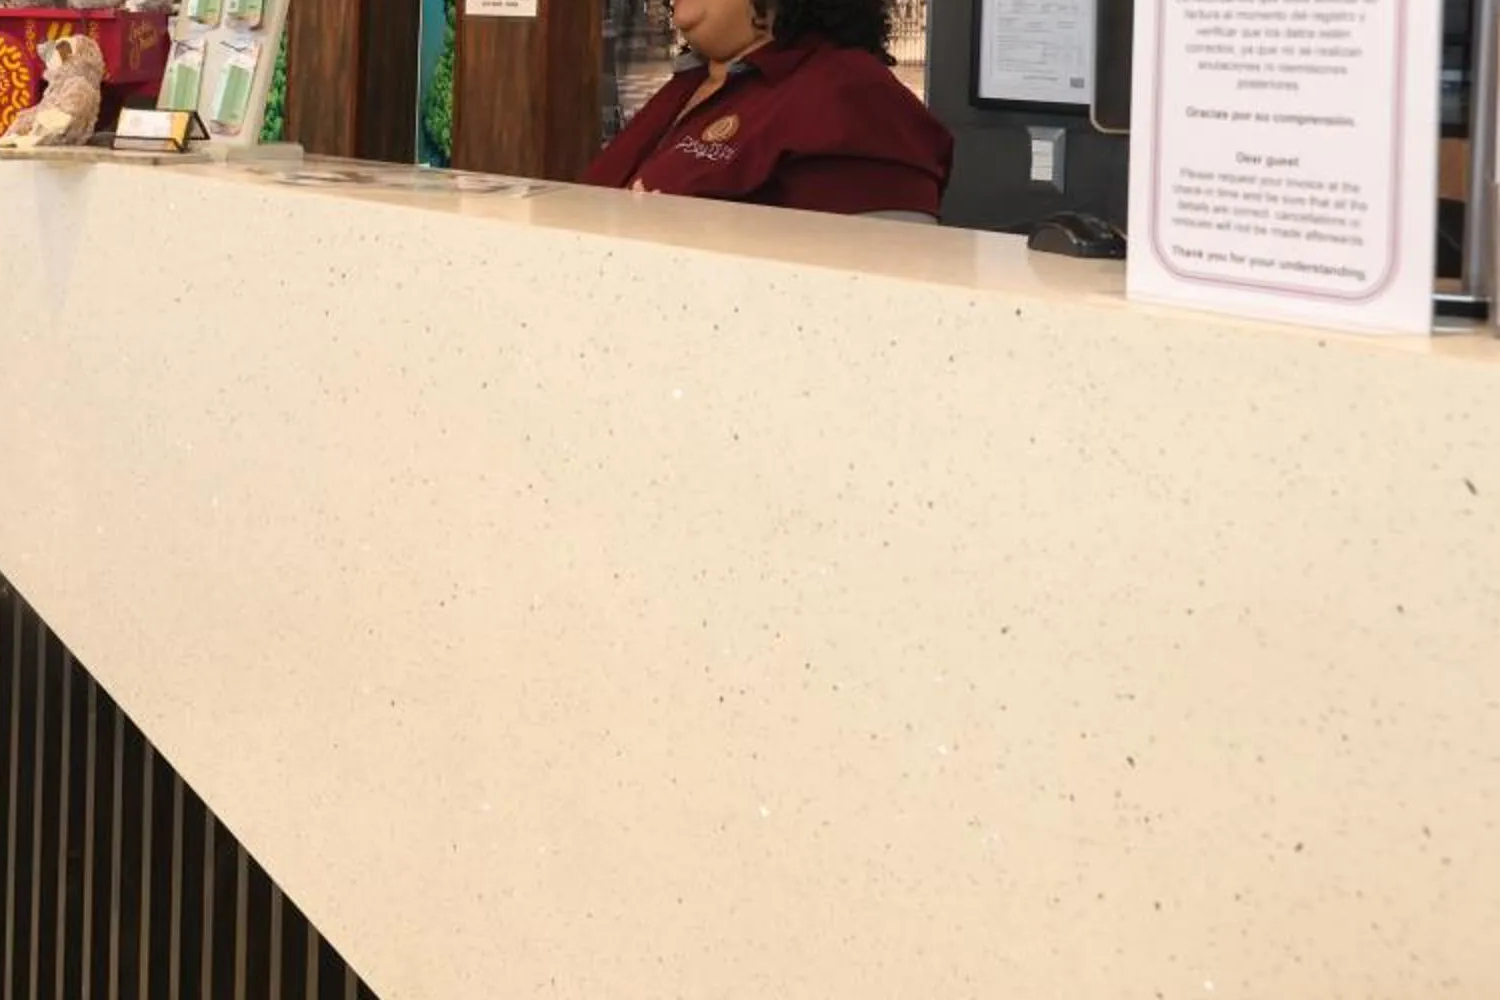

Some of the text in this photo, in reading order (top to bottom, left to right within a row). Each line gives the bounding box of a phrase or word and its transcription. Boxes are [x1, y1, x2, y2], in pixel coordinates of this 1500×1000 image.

[1186, 106, 1228, 120] Gracias
[1231, 110, 1251, 121] por
[1255, 111, 1269, 122] su
[1236, 151, 1262, 165] Dear
[1179, 167, 1215, 180] Please
[1218, 171, 1257, 185] request
[1286, 177, 1323, 189] invoice
[1172, 244, 1204, 259] Thank
[1207, 251, 1227, 263] you
[1230, 252, 1247, 264] for
[1250, 256, 1275, 269] your
